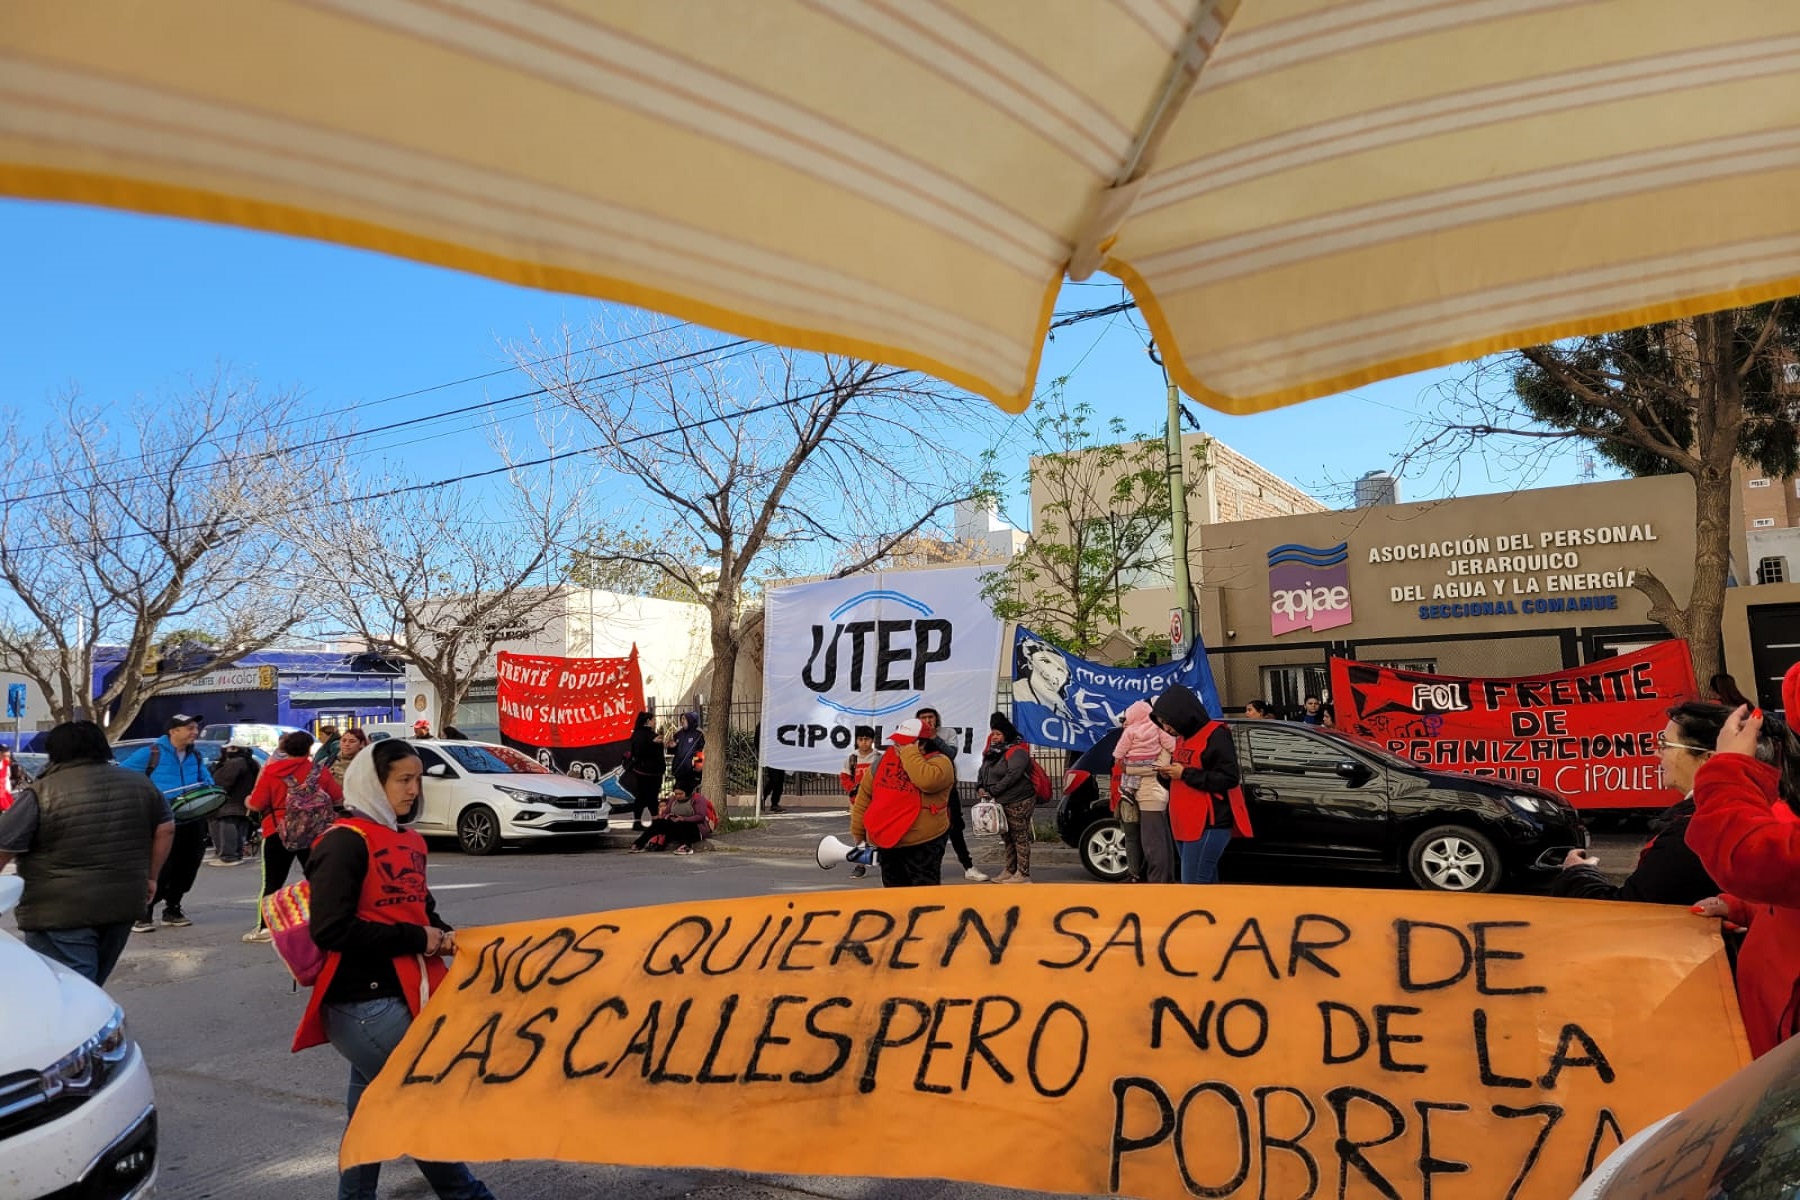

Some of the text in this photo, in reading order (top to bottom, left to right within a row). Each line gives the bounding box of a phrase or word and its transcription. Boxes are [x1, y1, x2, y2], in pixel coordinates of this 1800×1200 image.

[1368, 523, 1657, 564] ASOCIACIÓN DEL PERSONAL
[1390, 567, 1636, 603] DEL AGUA Y LA ENERGÍA
[1446, 551, 1579, 578] JERARQUICO
[1271, 580, 1350, 621] apjae
[1418, 594, 1619, 621] SECCIONAL COMAHUE
[801, 618, 953, 693] UTEP
[1412, 683, 1469, 711] FOL
[1484, 662, 1658, 711] FRENTE
[1510, 710, 1568, 738] DE
[457, 923, 621, 995] NOS
[1037, 904, 1352, 983] SACAR
[1393, 917, 1548, 996] DE
[401, 1005, 559, 1088] LAS
[1150, 996, 1270, 1059] NO
[1316, 1000, 1429, 1074] DE
[1472, 1007, 1617, 1090] LA
